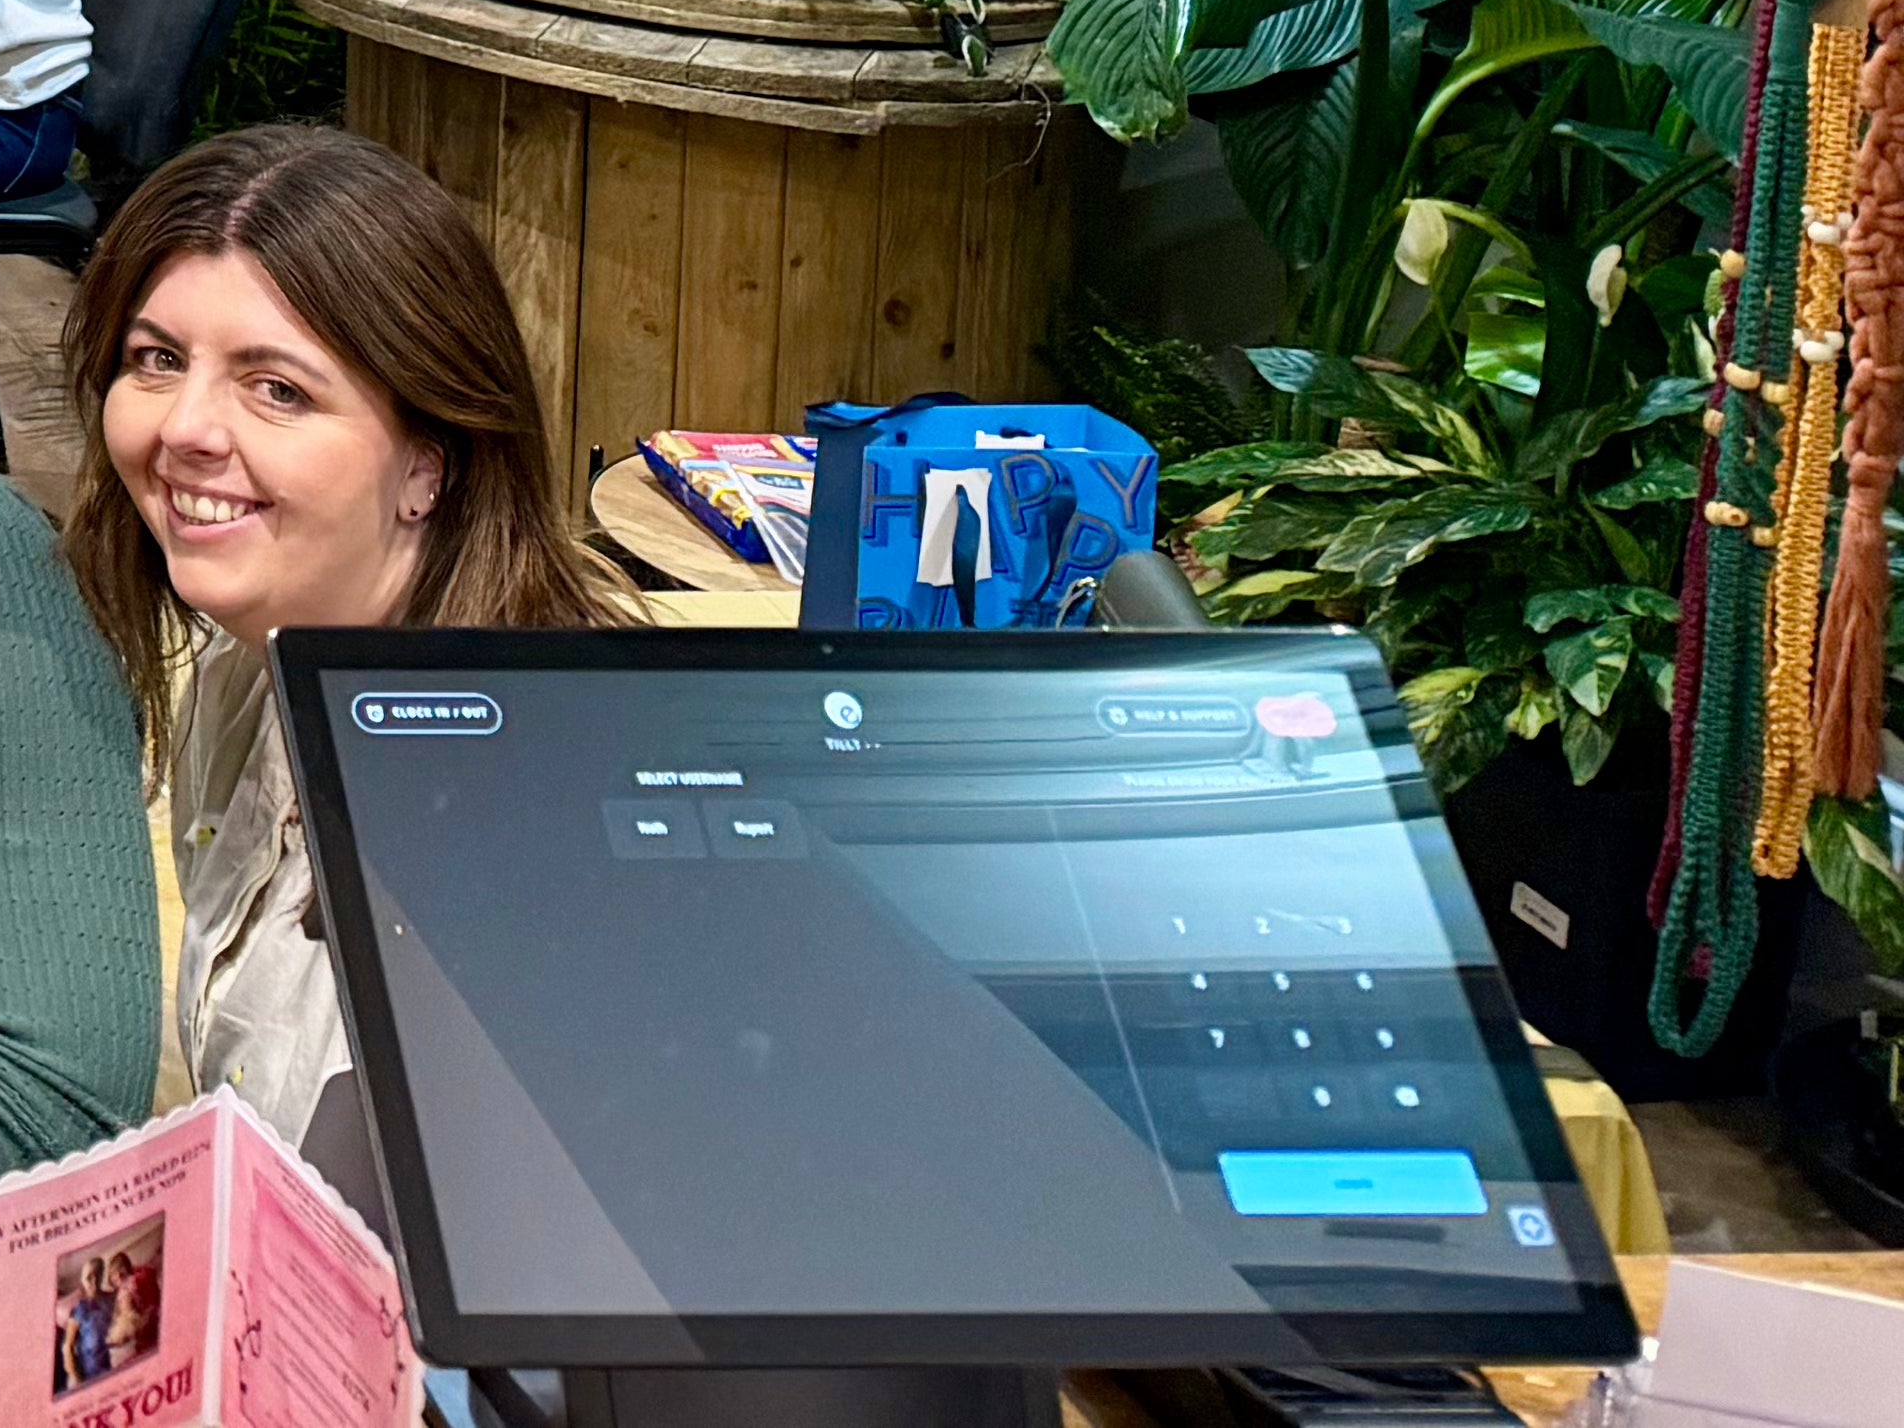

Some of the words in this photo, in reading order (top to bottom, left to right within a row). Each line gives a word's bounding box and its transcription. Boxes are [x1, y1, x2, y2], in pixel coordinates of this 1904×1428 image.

[863, 452, 1159, 588] HPPY
[392, 706, 432, 720] CLOCK
[461, 706, 489, 719] OUT
[1256, 917, 1271, 935] 2
[1209, 1028, 1225, 1048] 7
[8, 1232, 41, 1254] FOR
[44, 1211, 97, 1242] BREAST
[99, 1186, 155, 1220] CANCER
[159, 1169, 188, 1189] NOW
[11, 1192, 101, 1235] AFTERNOON
[103, 1180, 130, 1200] TEA
[132, 1157, 180, 1188] RAISED
